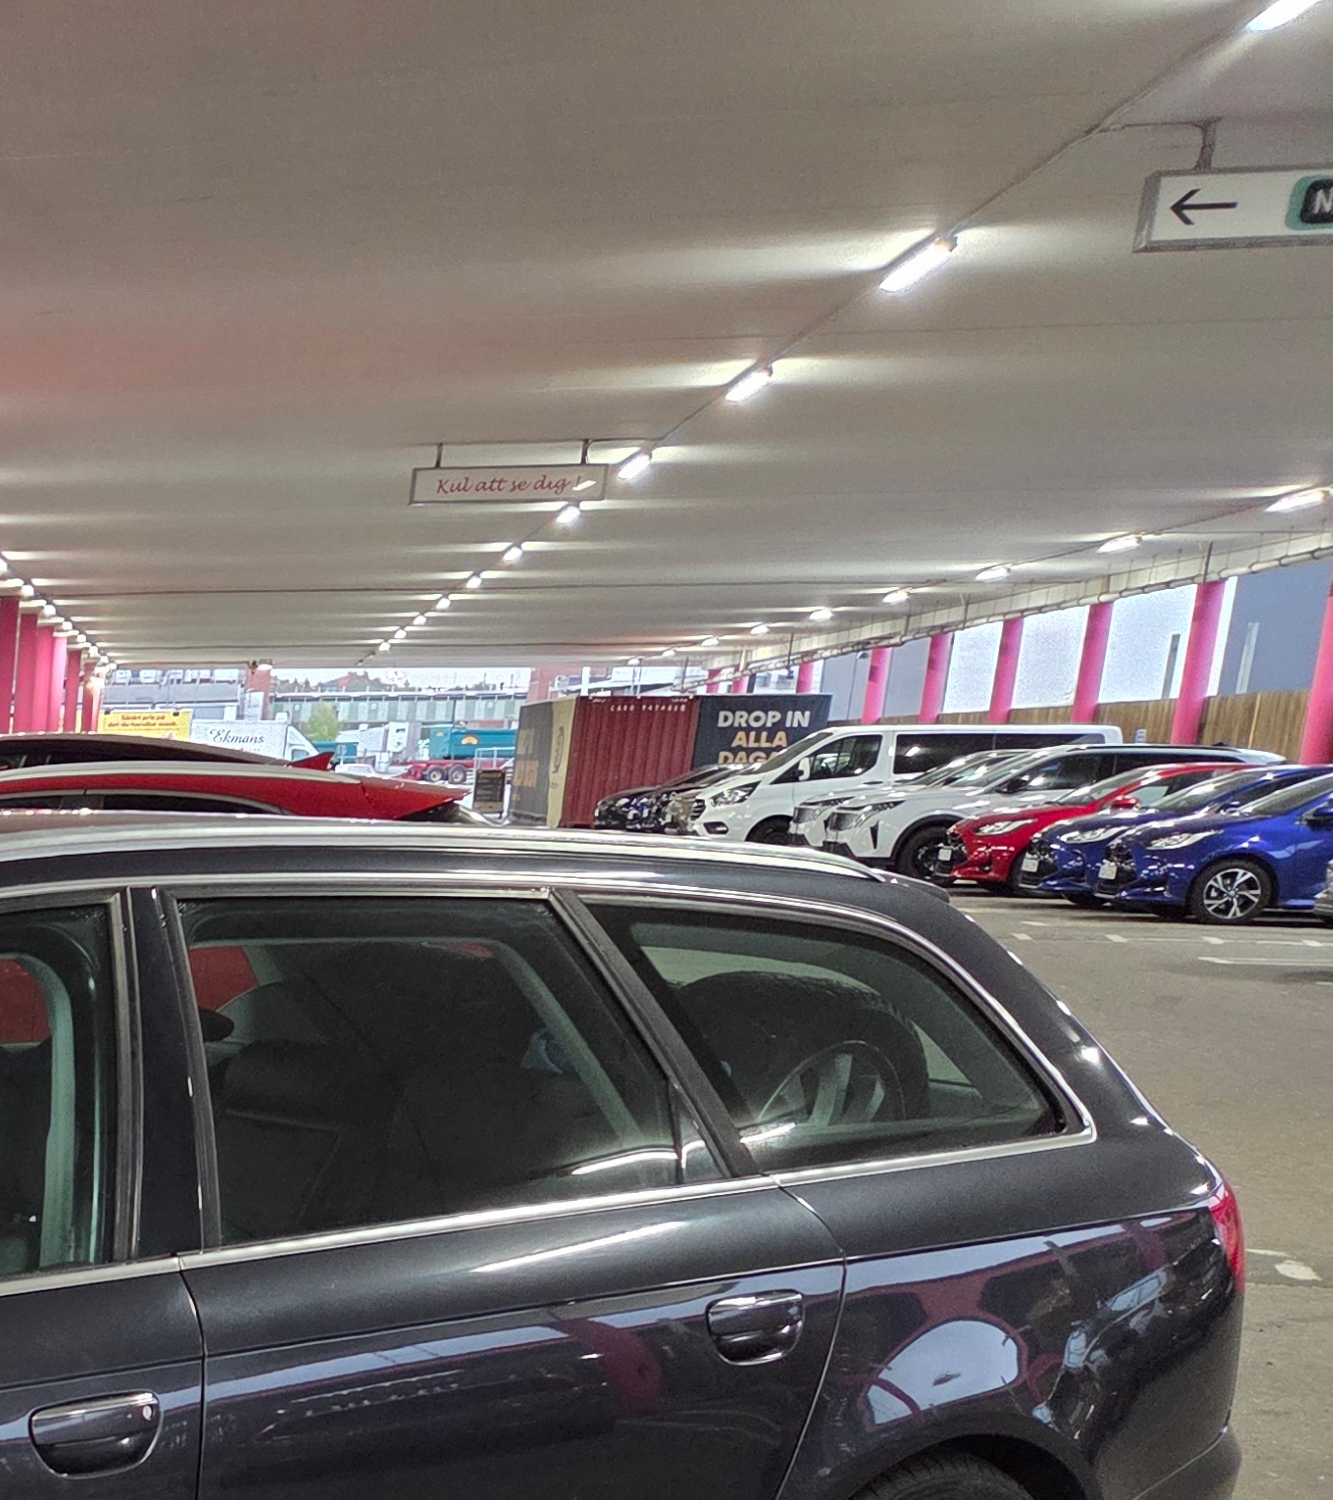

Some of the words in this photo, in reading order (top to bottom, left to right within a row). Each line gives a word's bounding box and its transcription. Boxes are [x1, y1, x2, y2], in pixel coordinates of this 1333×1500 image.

[437, 477, 472, 494] Kul
[475, 478, 507, 492] att
[509, 480, 530, 493] se
[533, 474, 570, 495] dig
[717, 710, 781, 728] DROP
[785, 710, 810, 728] IN
[210, 729, 264, 744] Ekmans
[731, 731, 787, 748] ALLA
